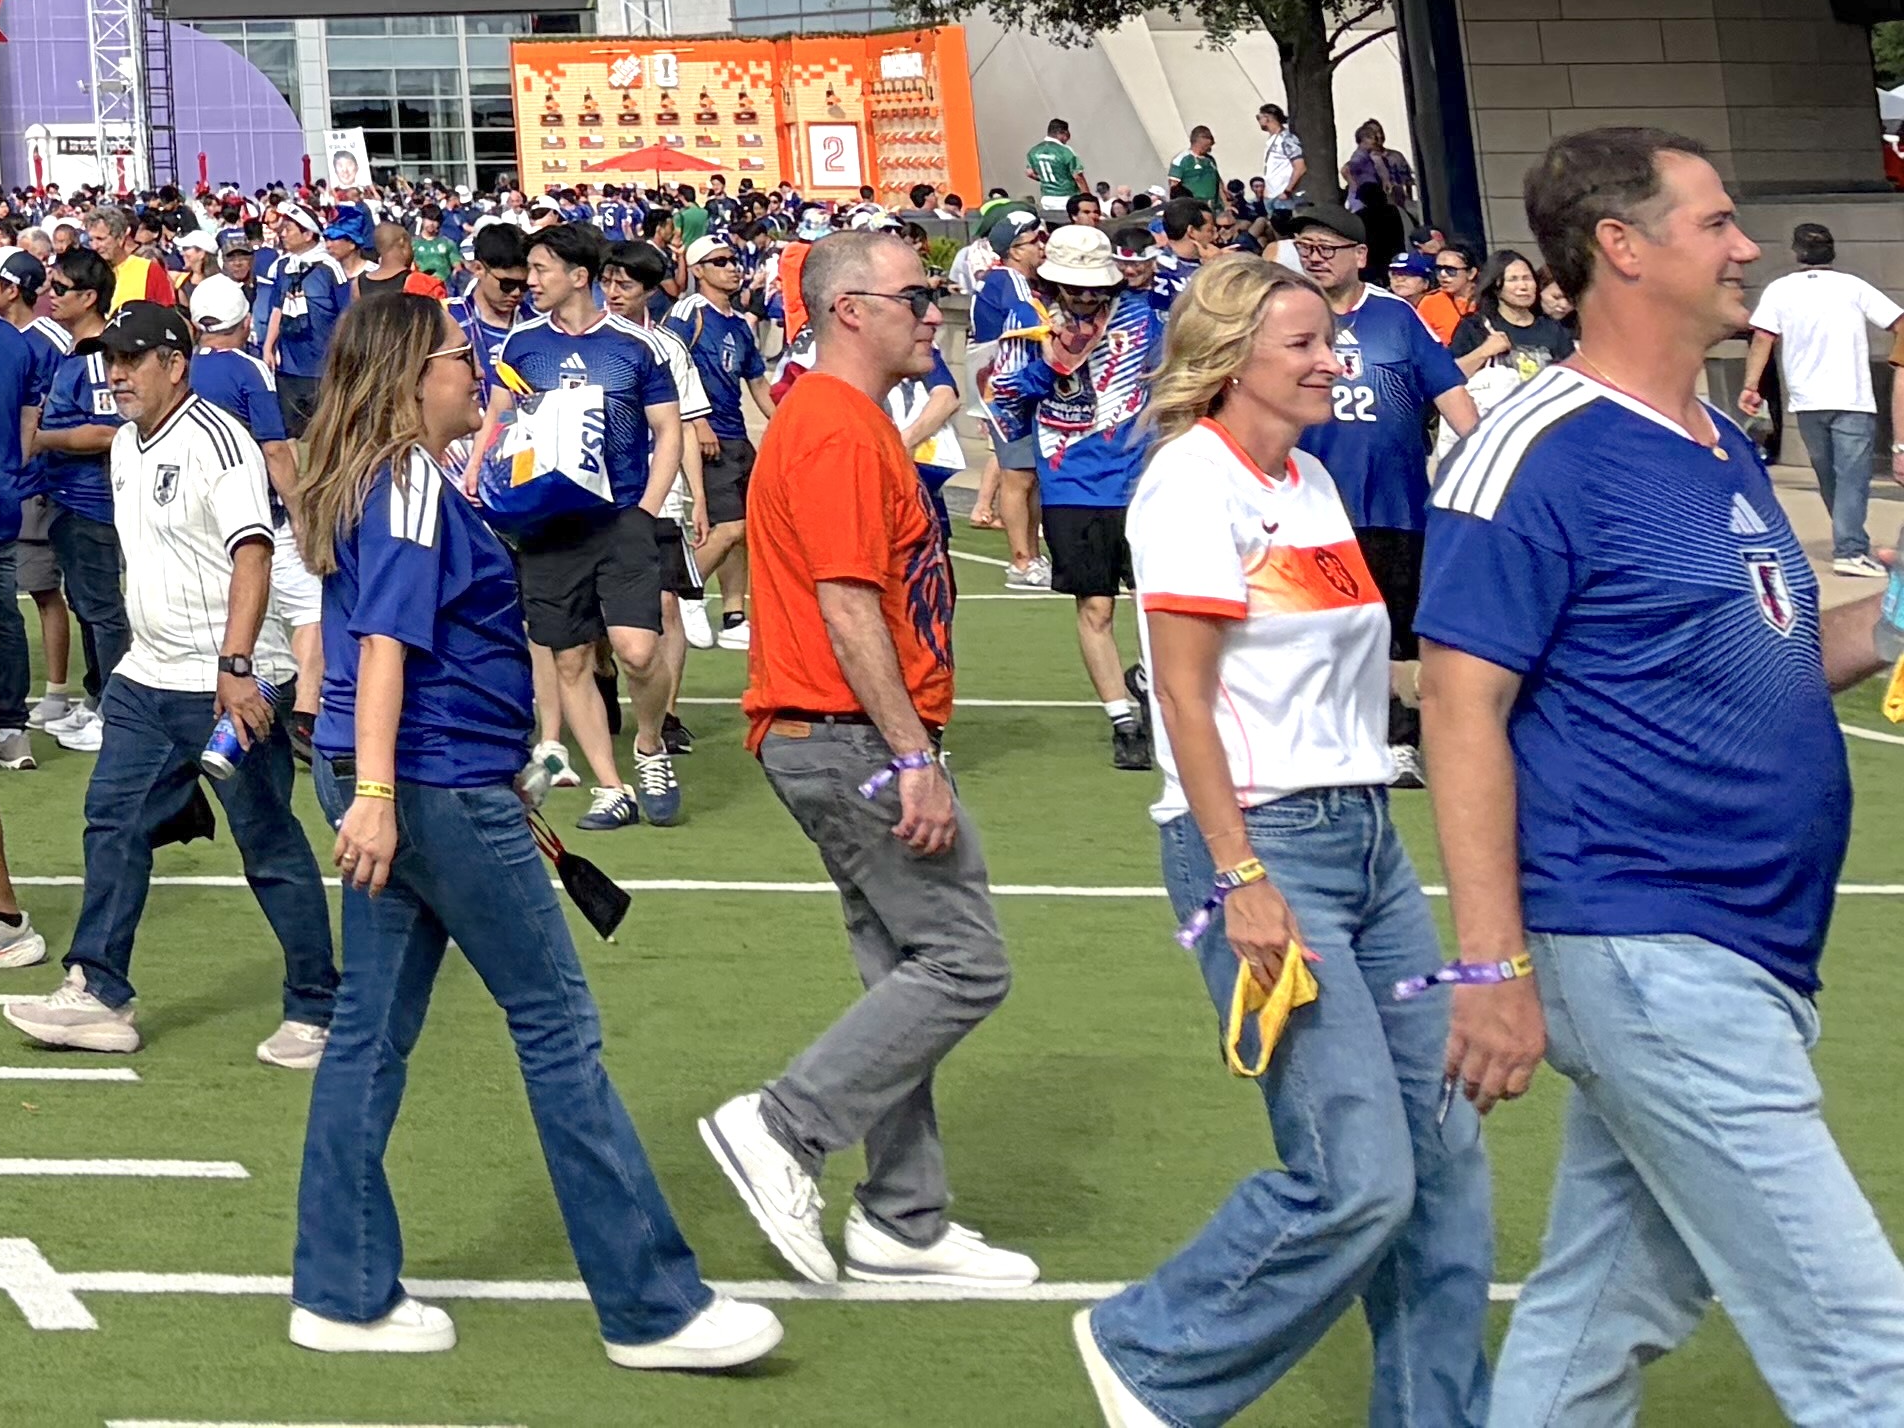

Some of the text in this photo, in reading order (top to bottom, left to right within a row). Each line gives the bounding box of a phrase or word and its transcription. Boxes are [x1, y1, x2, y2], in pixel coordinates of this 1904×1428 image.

[823, 136, 846, 172] 2
[1038, 160, 1057, 182] 11
[1331, 385, 1377, 422] 22
[578, 407, 606, 475] VISA
